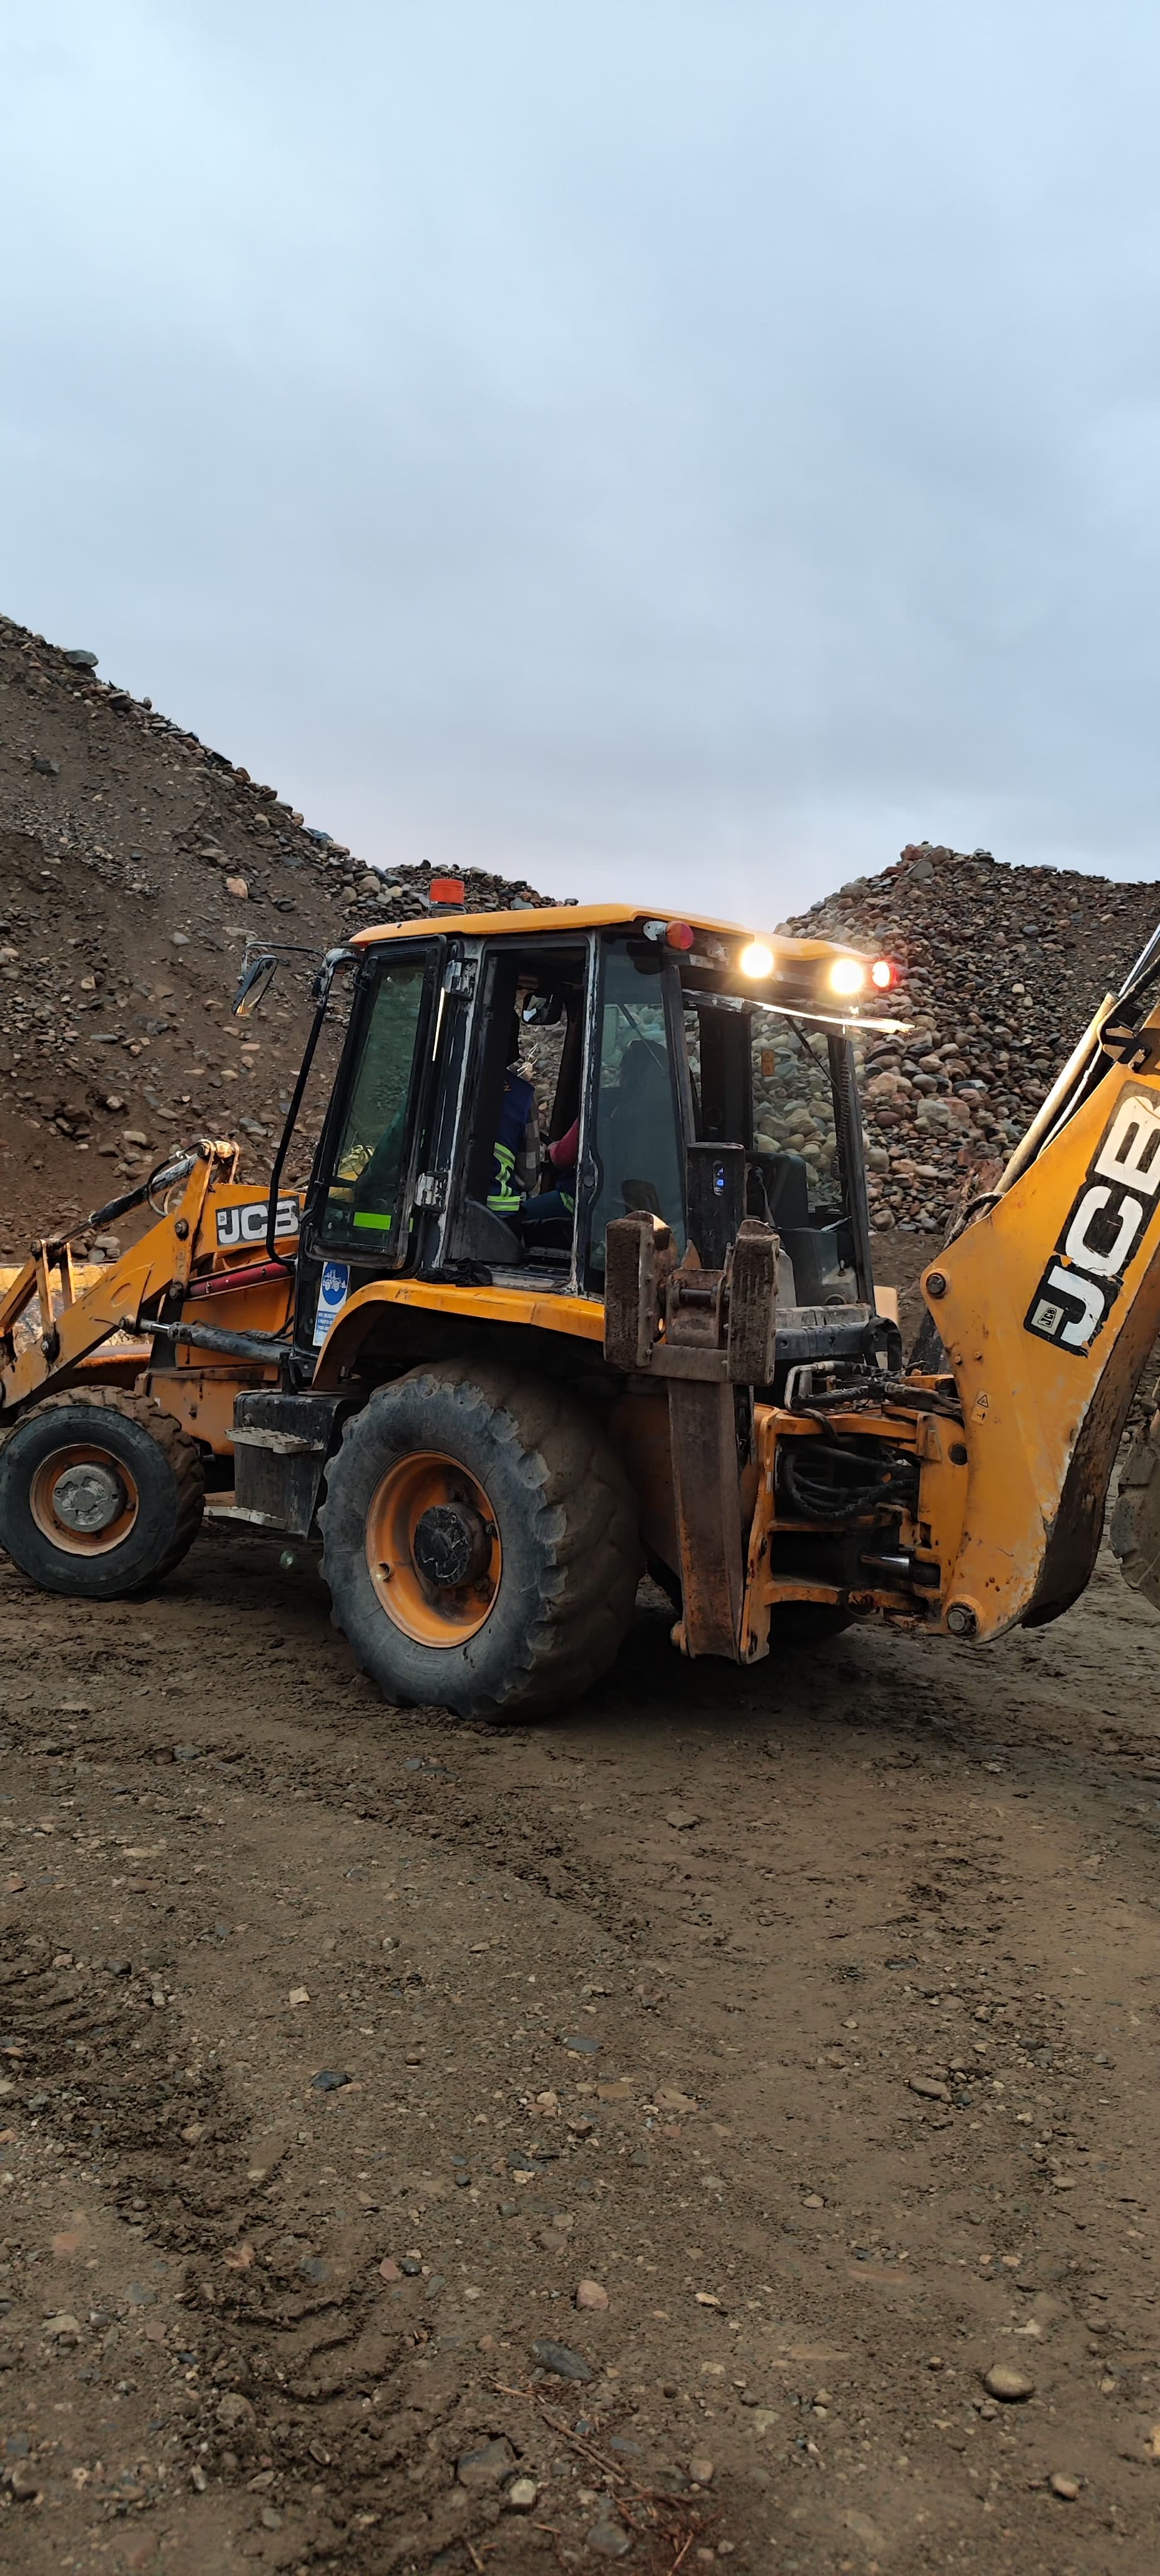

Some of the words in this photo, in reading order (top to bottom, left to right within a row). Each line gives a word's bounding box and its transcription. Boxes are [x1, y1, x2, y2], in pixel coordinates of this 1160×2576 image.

[217, 1200, 299, 1243] JCB
[1047, 1096, 1160, 1346] JCB
[1040, 1309, 1055, 1326] JCB
